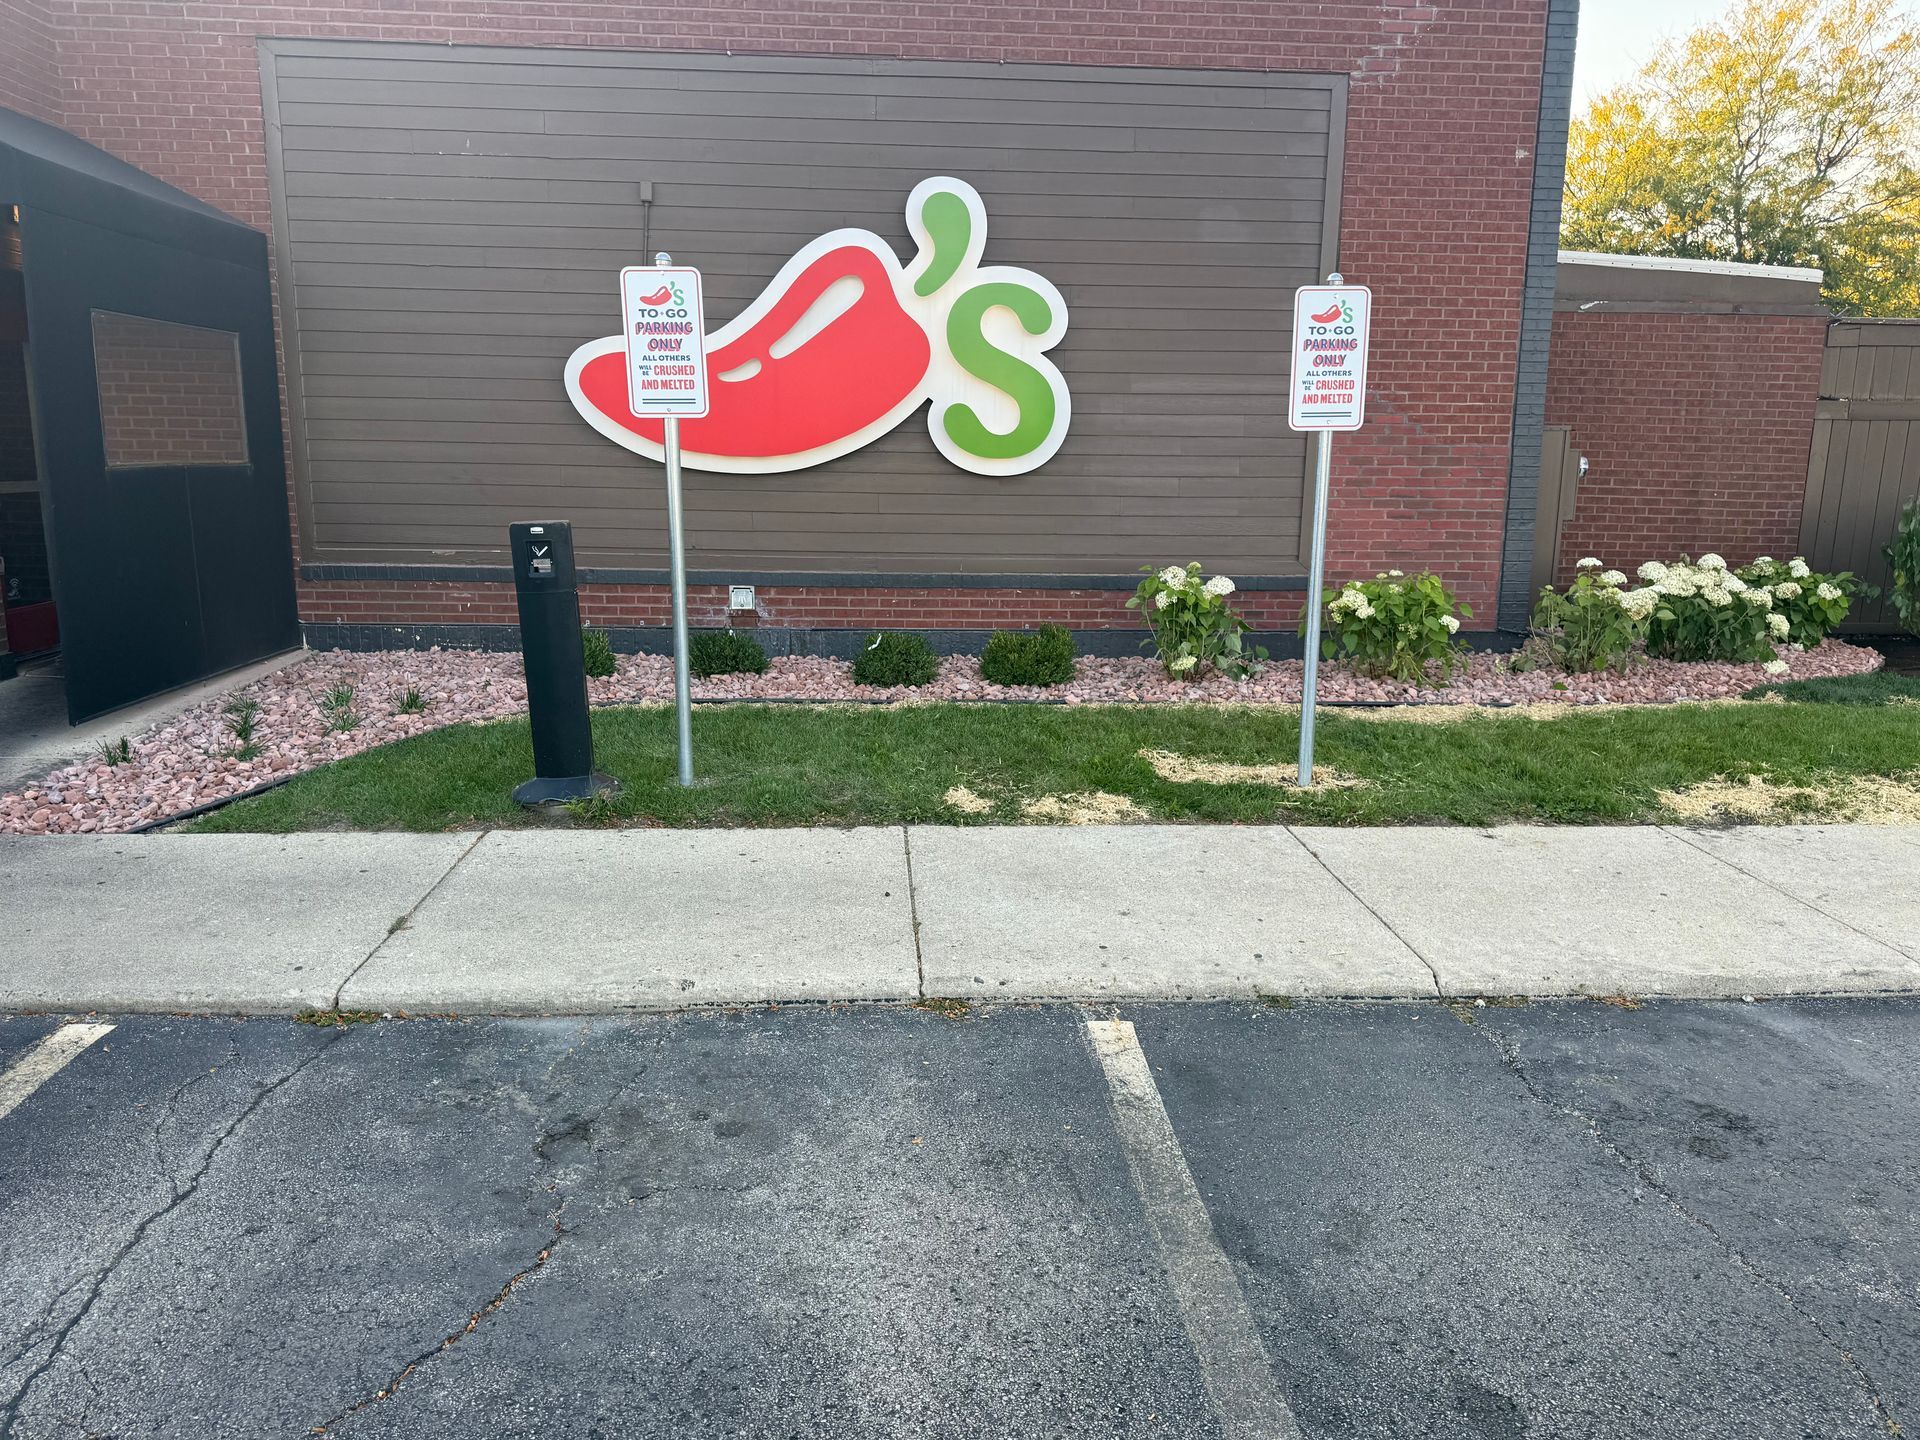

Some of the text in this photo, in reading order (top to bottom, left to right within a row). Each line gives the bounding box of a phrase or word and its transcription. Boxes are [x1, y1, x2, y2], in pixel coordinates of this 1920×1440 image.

[635, 322, 693, 335] PARKING
[647, 338, 682, 351] ONLY
[1303, 339, 1358, 351] PARKING
[1313, 355, 1346, 367] ONLY
[654, 365, 695, 375] CRUSHED
[642, 379, 695, 390] AND MELTED
[1316, 380, 1354, 390] CRUSHED
[1302, 394, 1352, 404] AND MELTED
